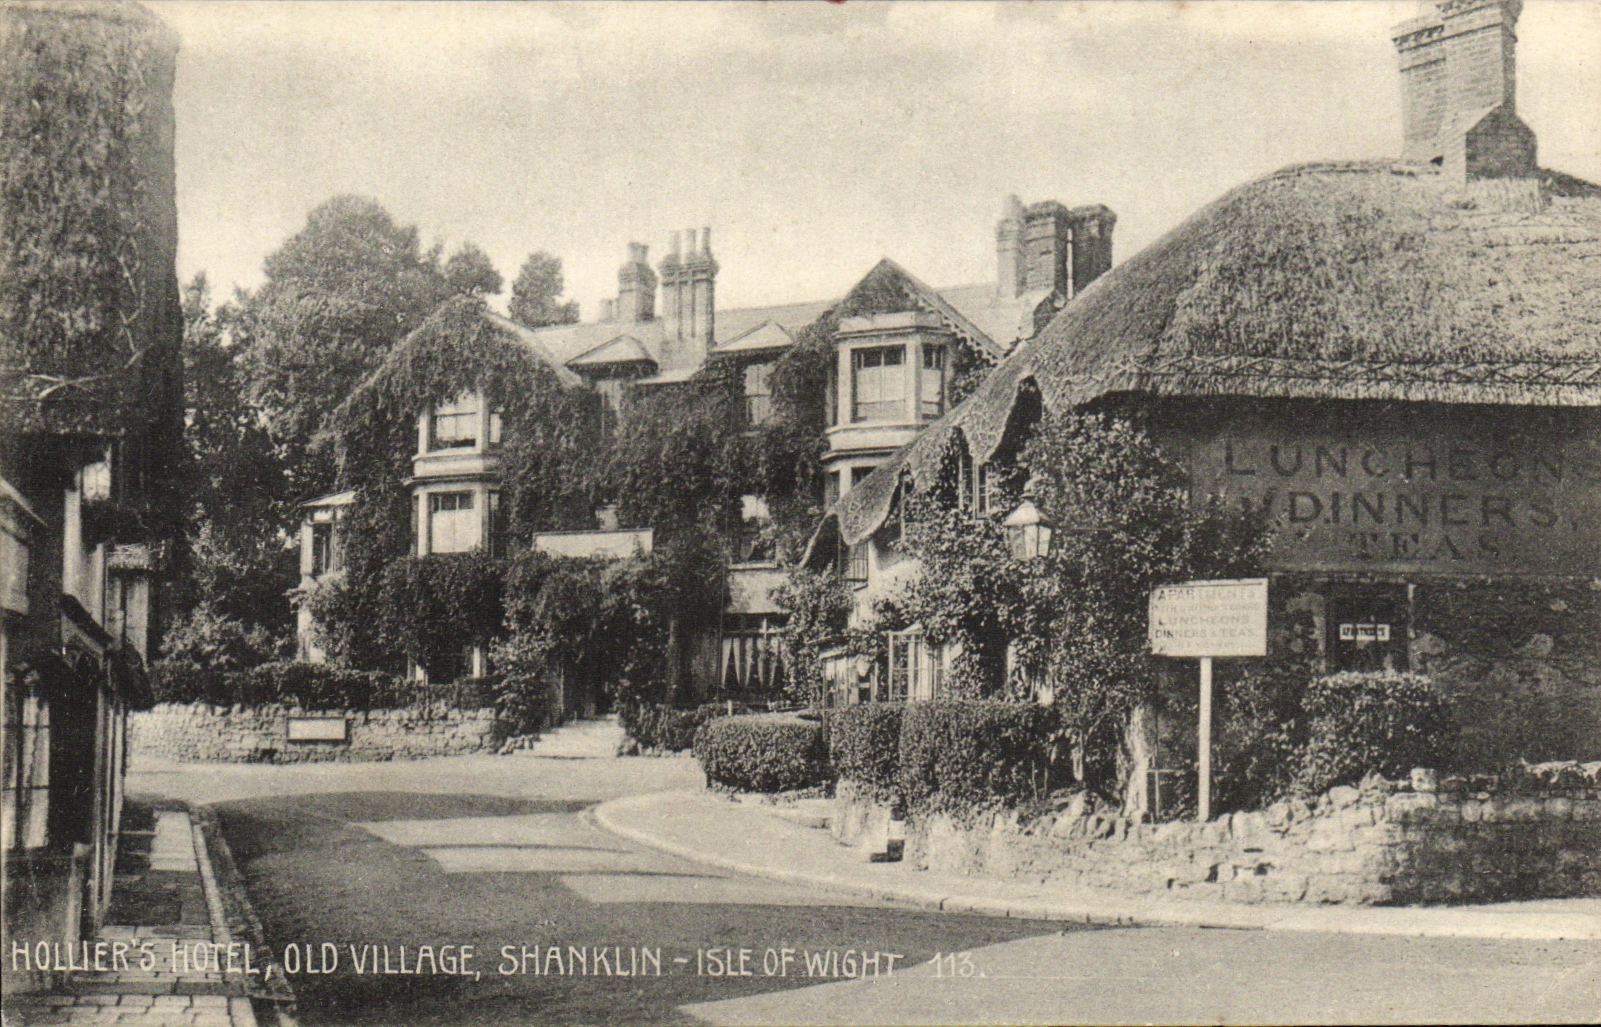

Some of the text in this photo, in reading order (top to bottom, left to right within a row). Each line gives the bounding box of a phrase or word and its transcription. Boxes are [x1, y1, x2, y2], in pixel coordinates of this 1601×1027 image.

[1349, 532, 1502, 560] TEAS
[1158, 615, 1250, 626] LUNCHEONS
[1155, 628, 1208, 639] DINNERS
